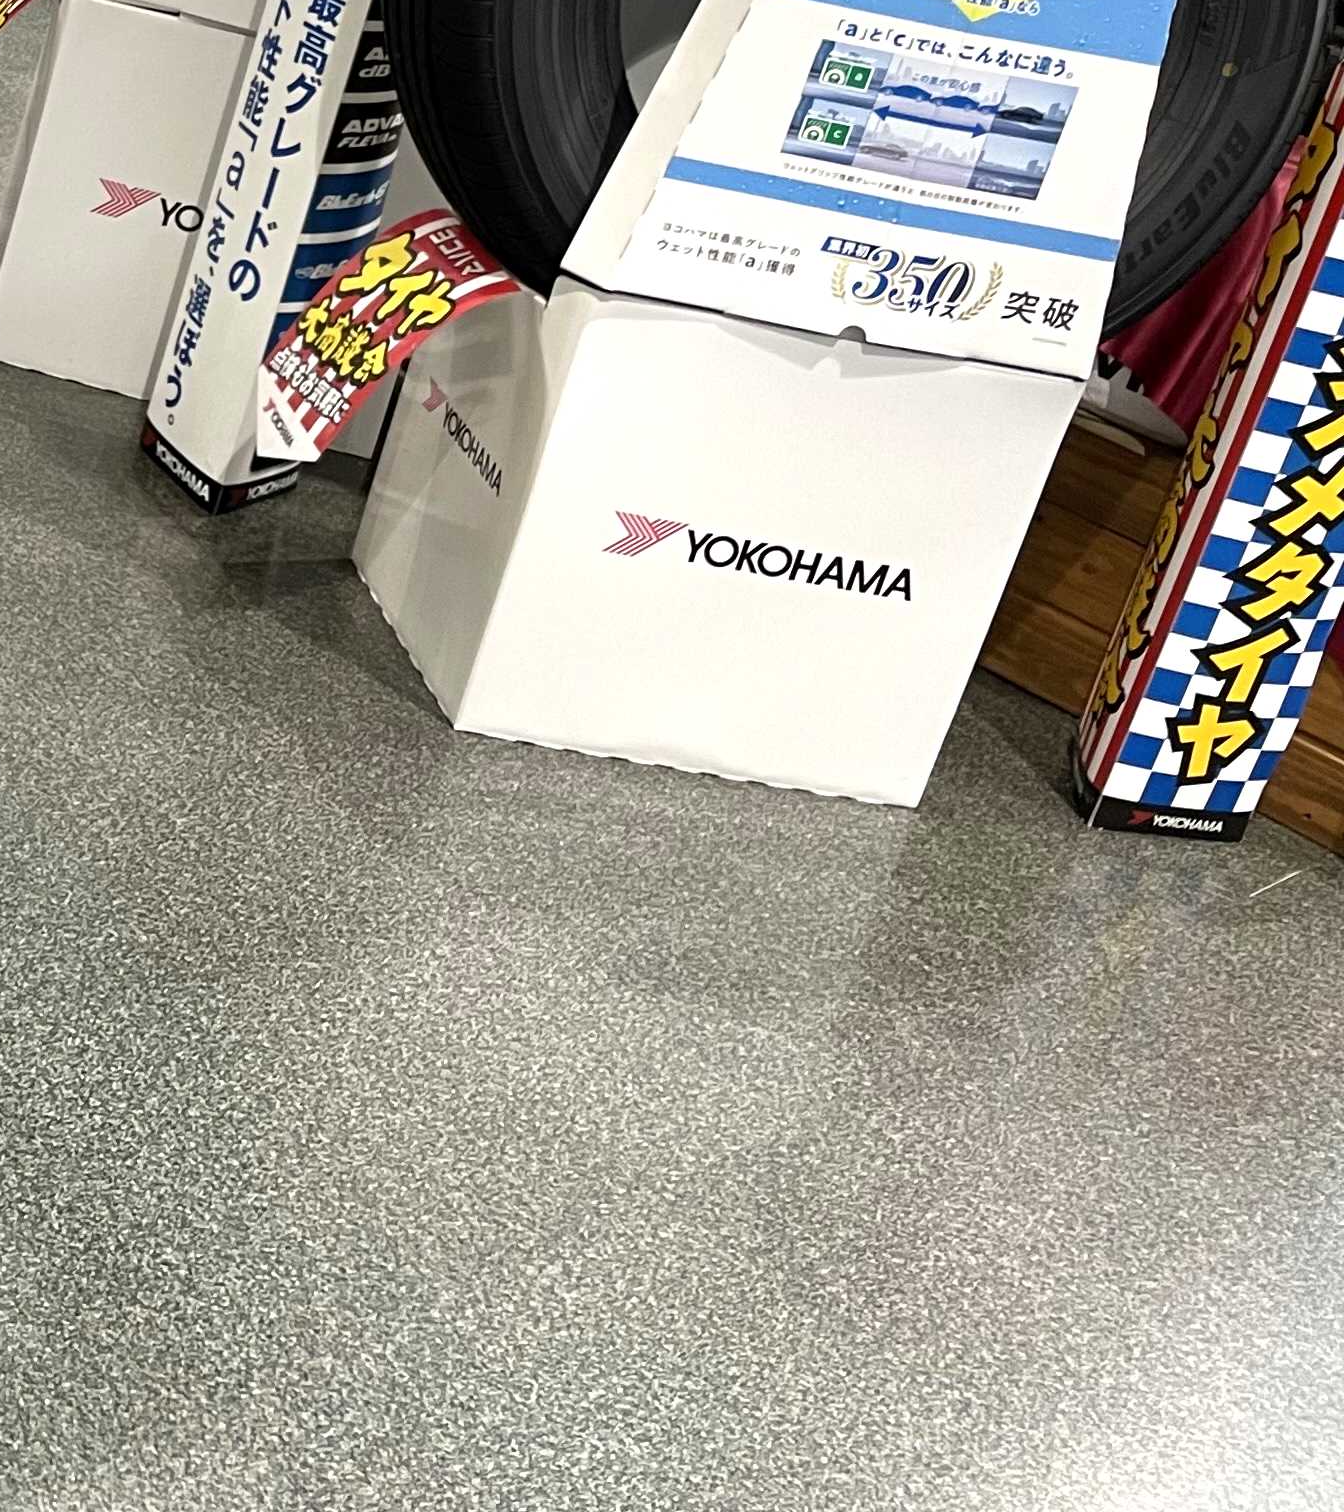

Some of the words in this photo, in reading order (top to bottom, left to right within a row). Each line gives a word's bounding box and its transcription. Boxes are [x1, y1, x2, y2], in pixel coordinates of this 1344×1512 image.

[836, 18, 1074, 80] 「a」と「c」では、こんなに違う。
[428, 226, 486, 278] ヨコハマ
[656, 239, 796, 277] ウェット性能「a」獲得
[662, 222, 801, 257] ヨコハマは最高グレードの
[339, 231, 458, 336] タイヤ
[851, 247, 972, 306] 350
[906, 298, 962, 320] サイズ
[1001, 291, 1080, 332] 突破
[154, 441, 210, 502] YOKOHAMA
[441, 400, 503, 497] YOKOHAMA
[686, 529, 914, 603] YOKOHAMA
[1152, 813, 1224, 833] YOKOHAMA
